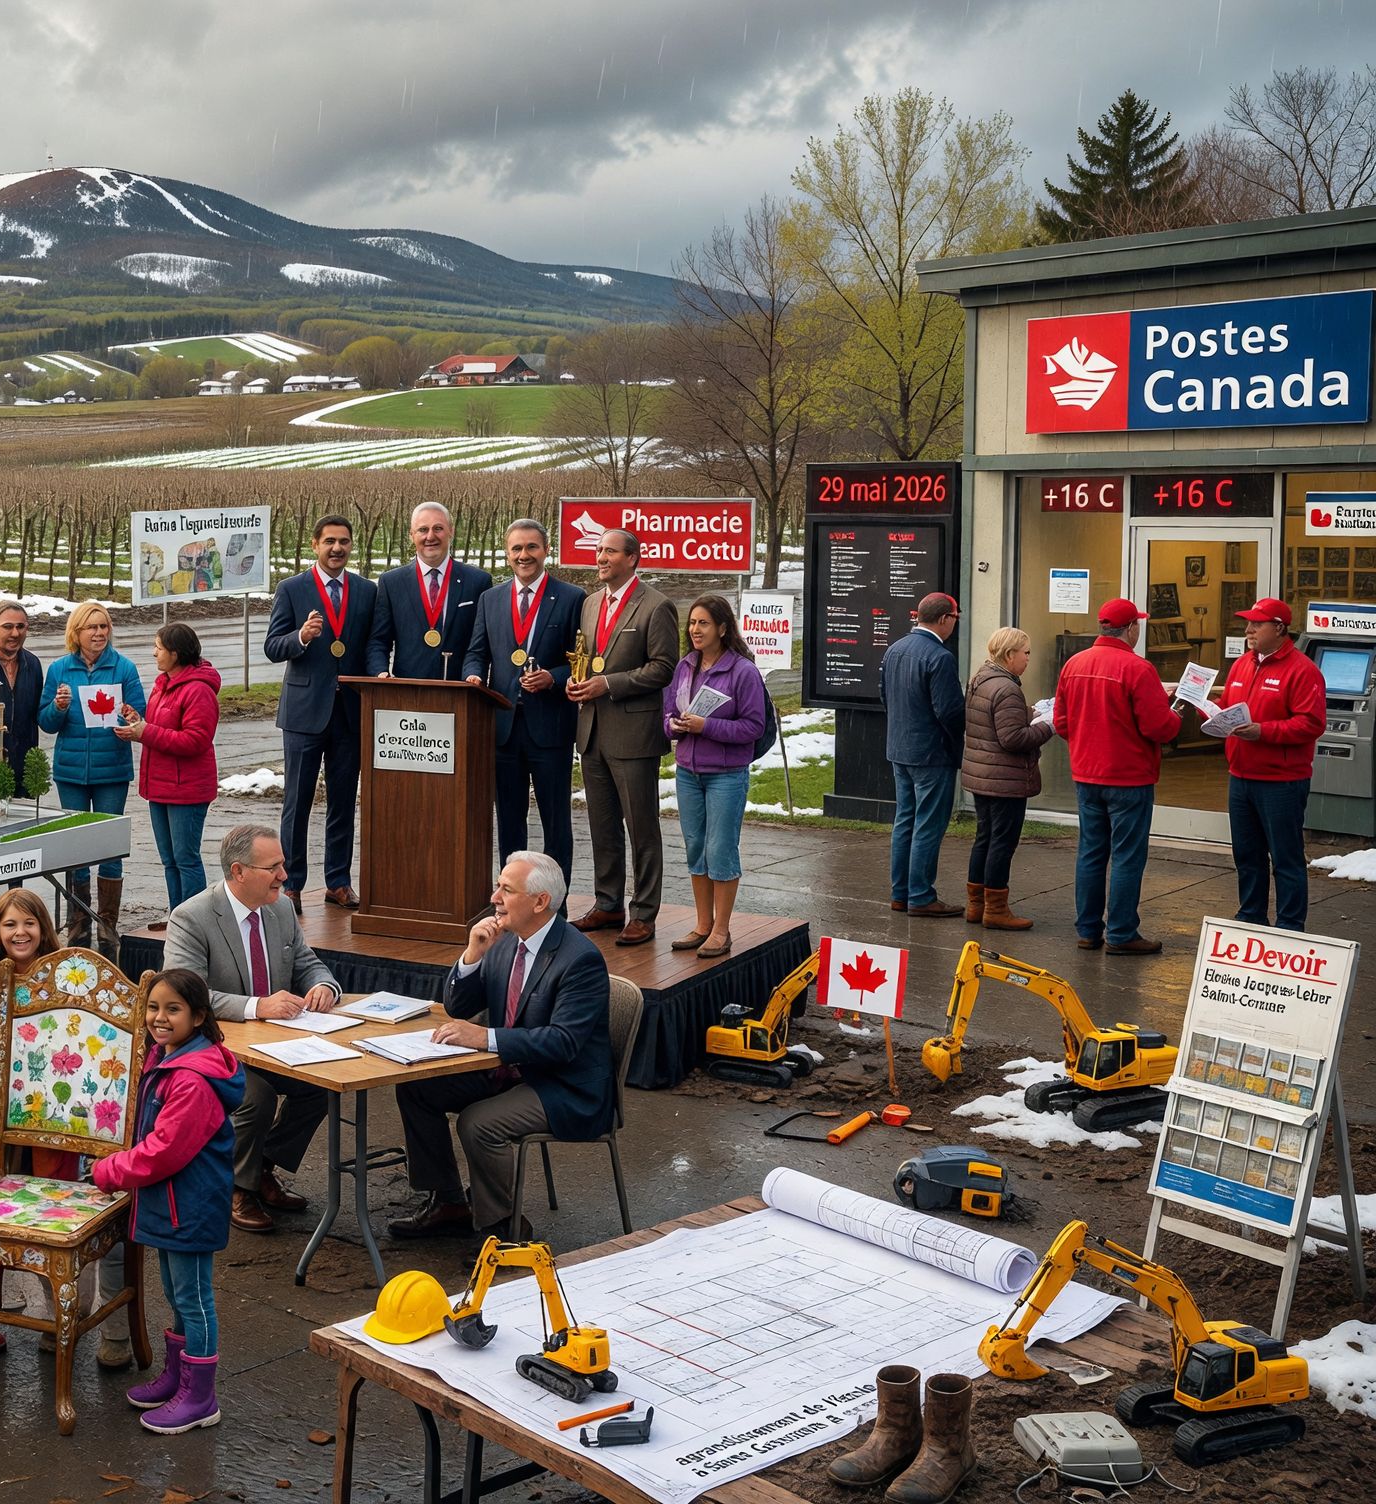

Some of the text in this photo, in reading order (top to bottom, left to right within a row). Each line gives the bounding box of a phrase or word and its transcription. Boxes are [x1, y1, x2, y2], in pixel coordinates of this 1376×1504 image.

[1145, 320, 1289, 360] Postes
[1143, 358, 1350, 414] Canada
[819, 475, 946, 502] 29 mai 2026
[1044, 483, 1114, 508] +16 C
[1153, 480, 1233, 508] +16 C
[621, 508, 743, 534] Pharmacie
[639, 543, 674, 560] ean
[1210, 931, 1328, 977] Le Devoir
